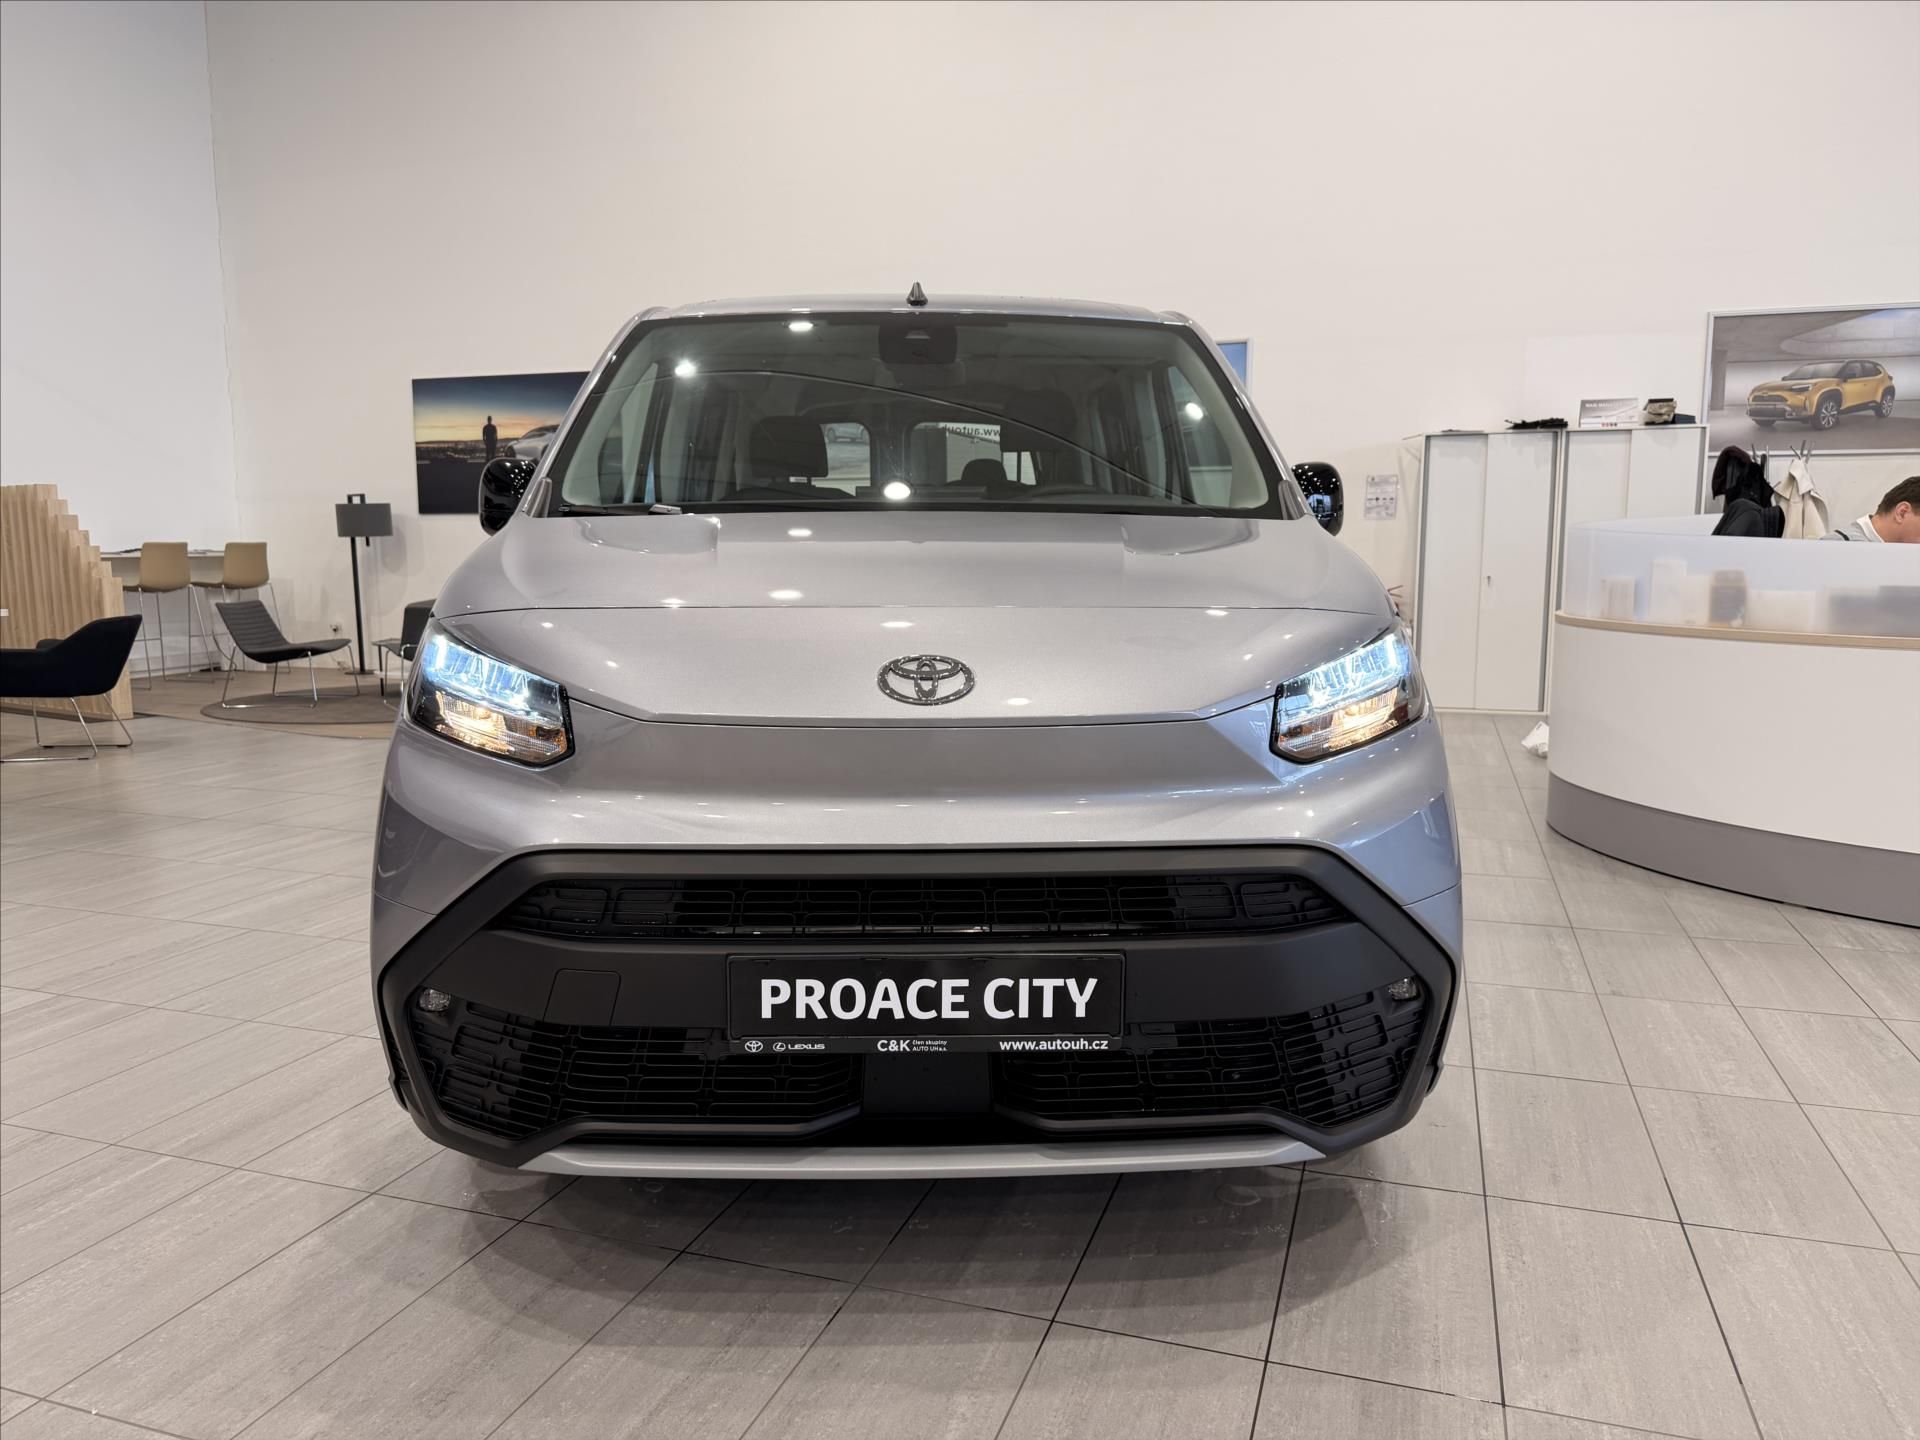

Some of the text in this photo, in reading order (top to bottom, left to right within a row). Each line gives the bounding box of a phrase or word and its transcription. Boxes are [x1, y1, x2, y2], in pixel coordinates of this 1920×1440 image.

[760, 977, 1098, 1020] PROACE CITY
[876, 1039, 911, 1052] C&K
[999, 1038, 1109, 1051] www.autouh.cz
